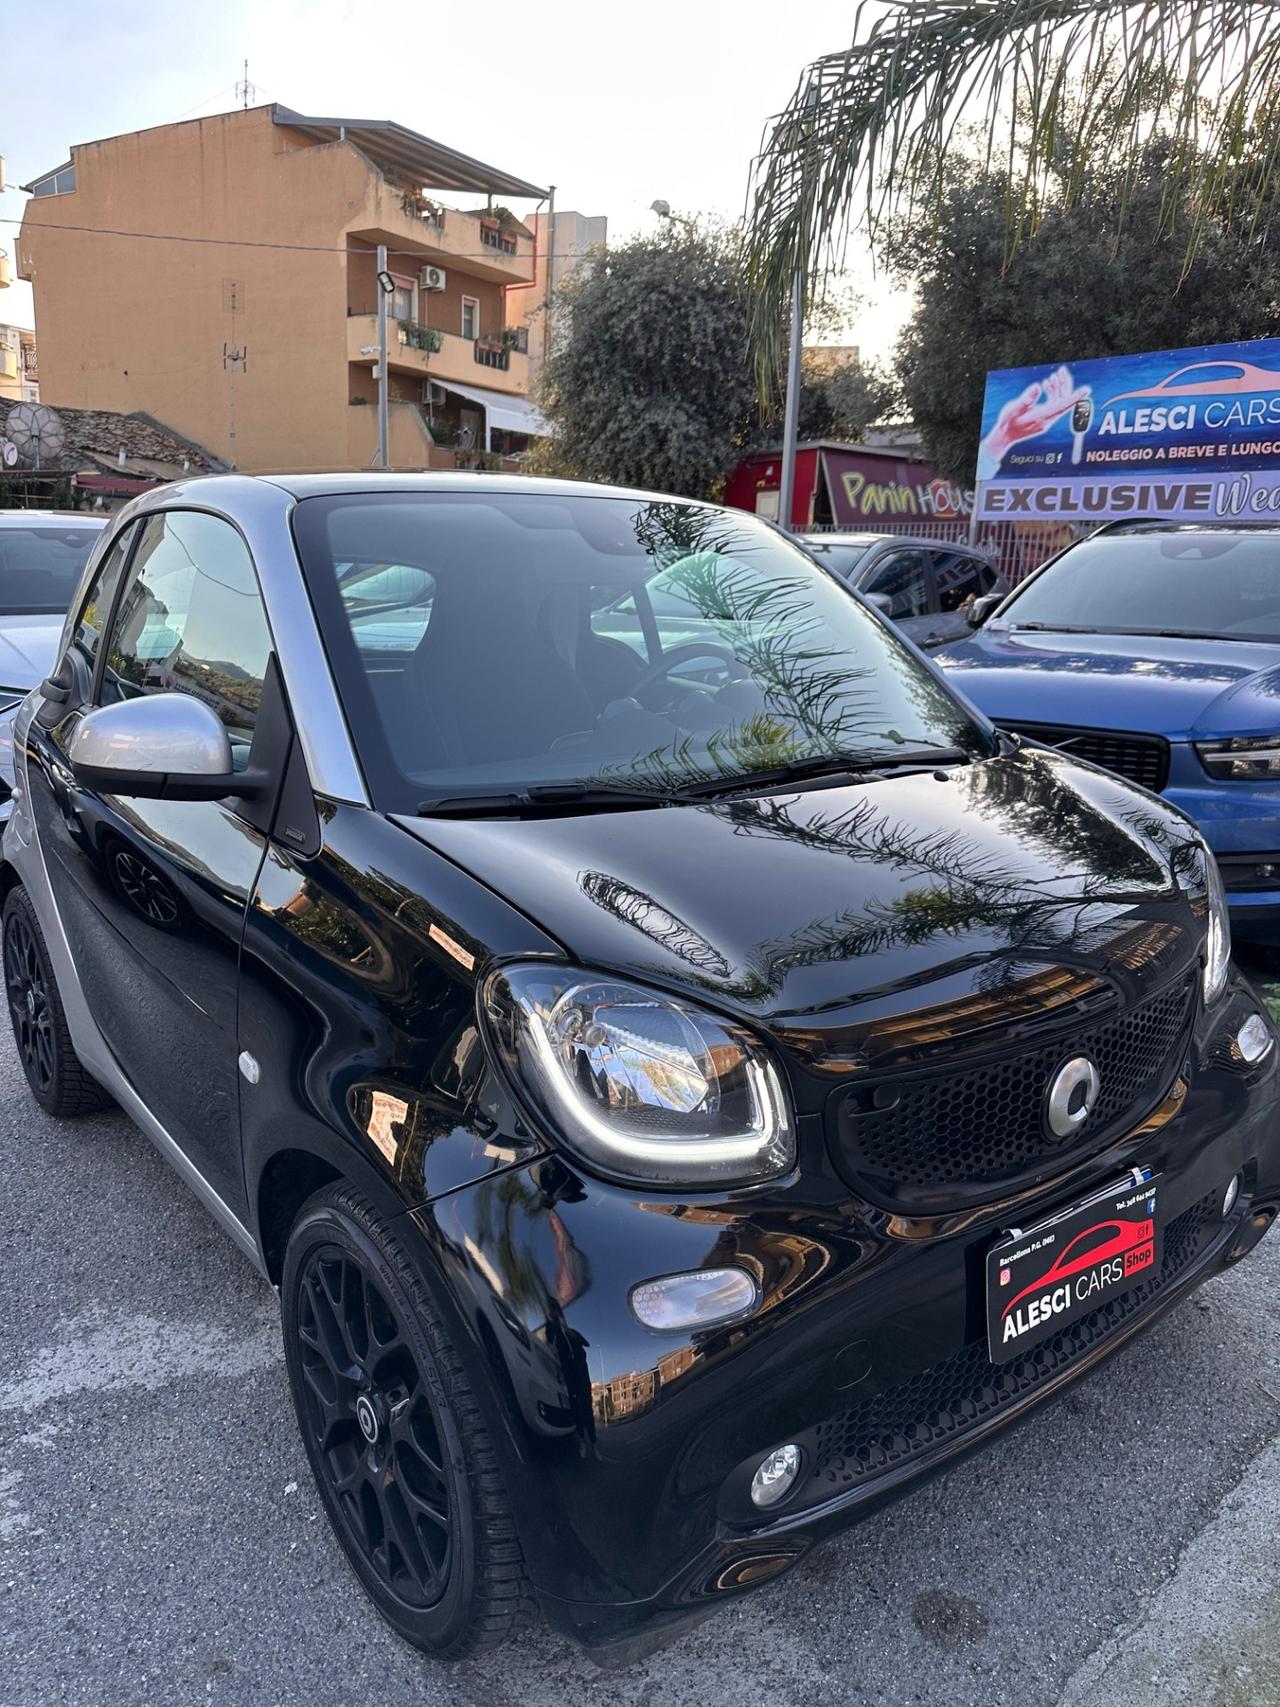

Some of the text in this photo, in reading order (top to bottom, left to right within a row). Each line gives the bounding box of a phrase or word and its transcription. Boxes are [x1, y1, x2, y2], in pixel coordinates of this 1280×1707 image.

[1098, 397, 1280, 435] ALESCI CARS
[1086, 448, 1153, 463] NOLEGGIO
[1155, 448, 1166, 460] A
[1168, 444, 1216, 459] BREVE
[1217, 444, 1229, 456] E
[983, 483, 1213, 513] EXCLUSIVE
[1126, 1248, 1151, 1269] Shop
[1002, 1257, 1123, 1344] ALESCI CARS
